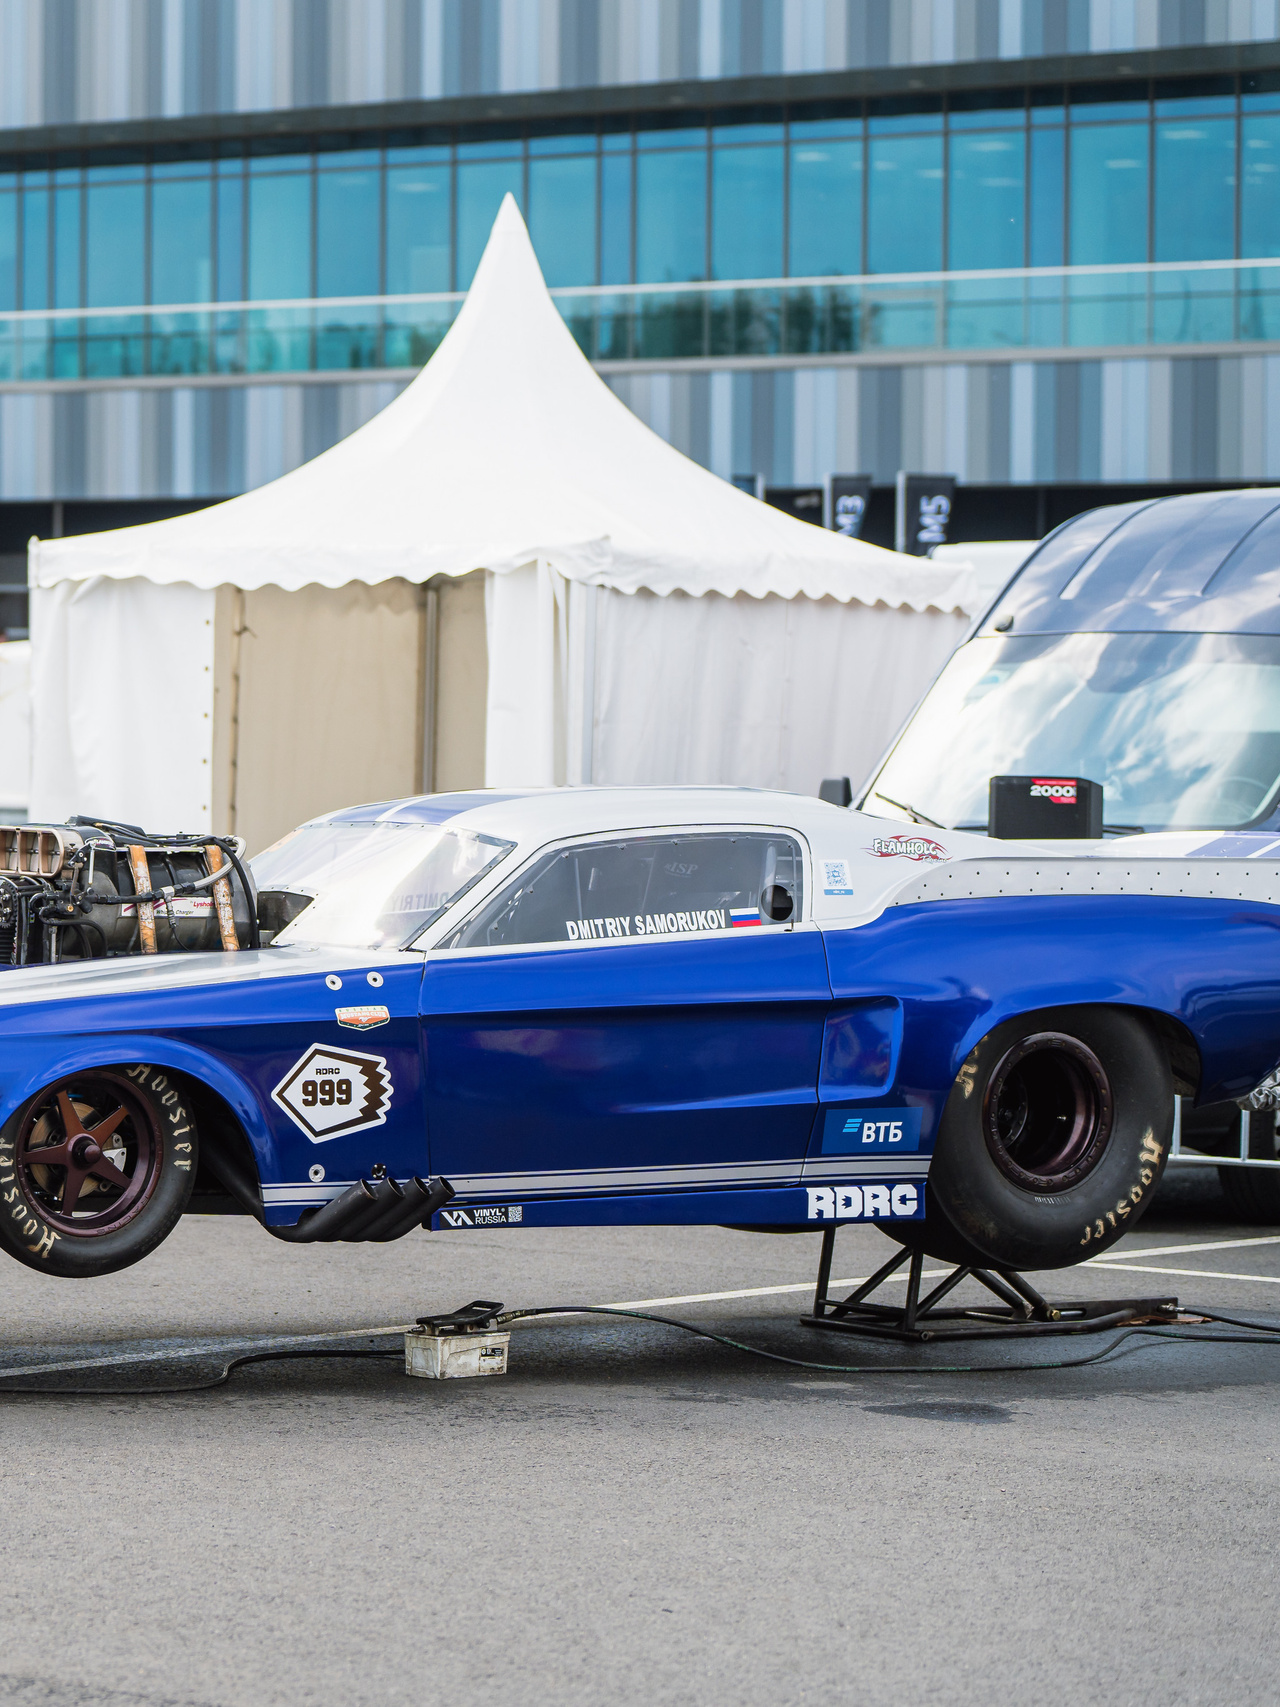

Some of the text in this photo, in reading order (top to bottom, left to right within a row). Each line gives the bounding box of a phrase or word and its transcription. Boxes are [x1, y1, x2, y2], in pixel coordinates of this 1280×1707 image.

[917, 495, 951, 543] M5
[1030, 785, 1073, 797] 2000
[566, 909, 726, 940] DMITRIY SAMORUKOV
[315, 1067, 341, 1076] RDRC
[302, 1078, 352, 1107] 999
[861, 1121, 903, 1143] ВТБ
[806, 1184, 918, 1219] RDRC
[475, 1215, 507, 1225] RUSSIA
